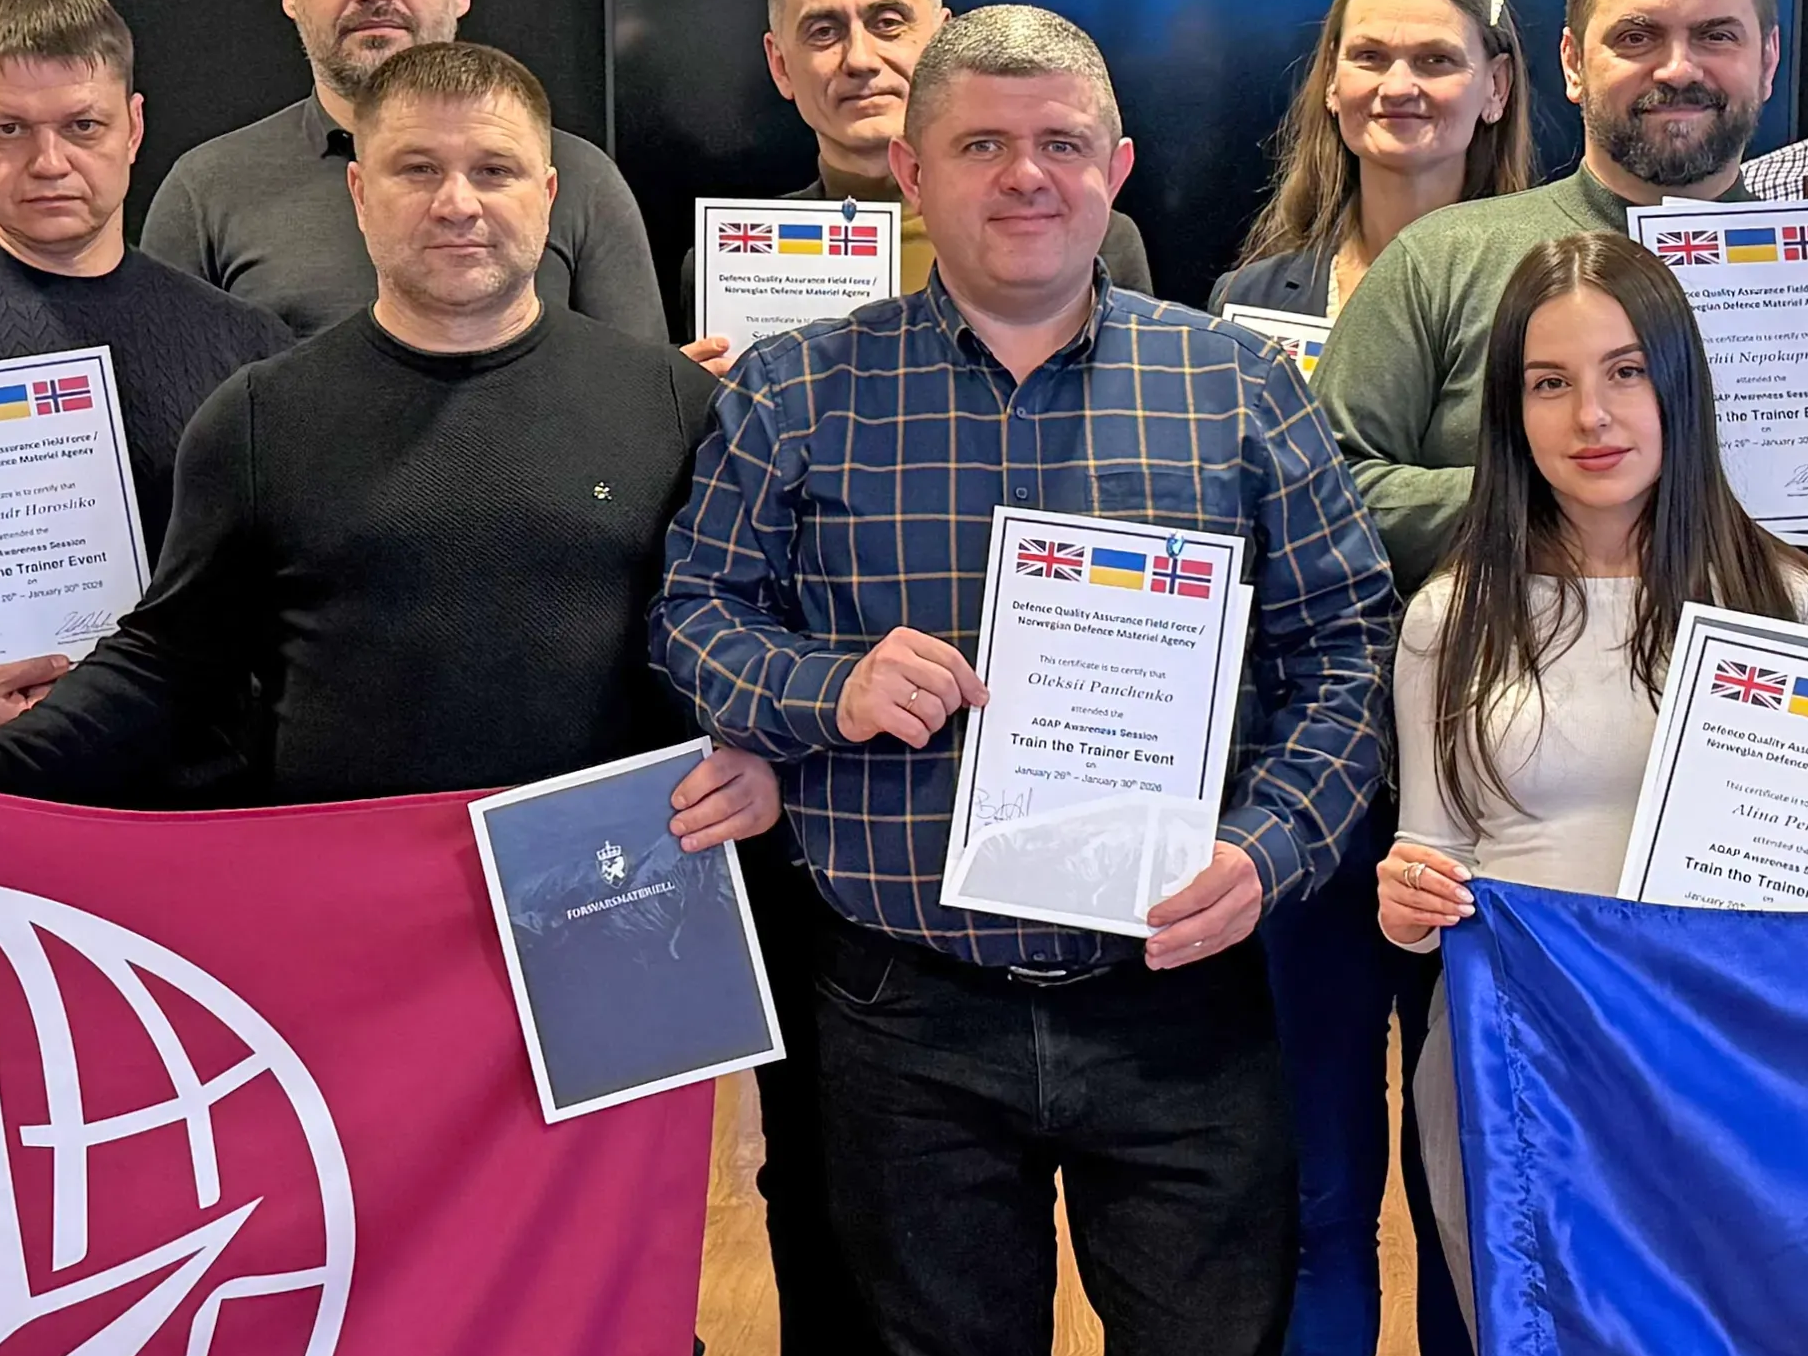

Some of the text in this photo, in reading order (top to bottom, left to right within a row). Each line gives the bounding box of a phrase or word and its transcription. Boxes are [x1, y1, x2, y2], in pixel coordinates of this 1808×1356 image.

[1709, 351, 1734, 364] rhii
[1725, 410, 1747, 421] the
[1750, 408, 1799, 420] Trainer
[15, 558, 64, 574] Trainer
[67, 551, 107, 567] Event
[1011, 599, 1053, 614] Defence
[1053, 605, 1091, 620] Quality
[1091, 610, 1143, 626] Assurance
[1144, 617, 1169, 629] Field
[1170, 621, 1197, 633] Force
[1017, 615, 1196, 649] Norwegian Defence Materiel Agency
[1027, 672, 1085, 690] Oleksii
[1030, 716, 1158, 741] AQAP Awareness Session
[1010, 732, 1174, 766] Train the Trainer Event
[1685, 855, 1722, 876] Train
[1727, 867, 1751, 883] the
[566, 881, 676, 920] FORSVARSMATERIELL
